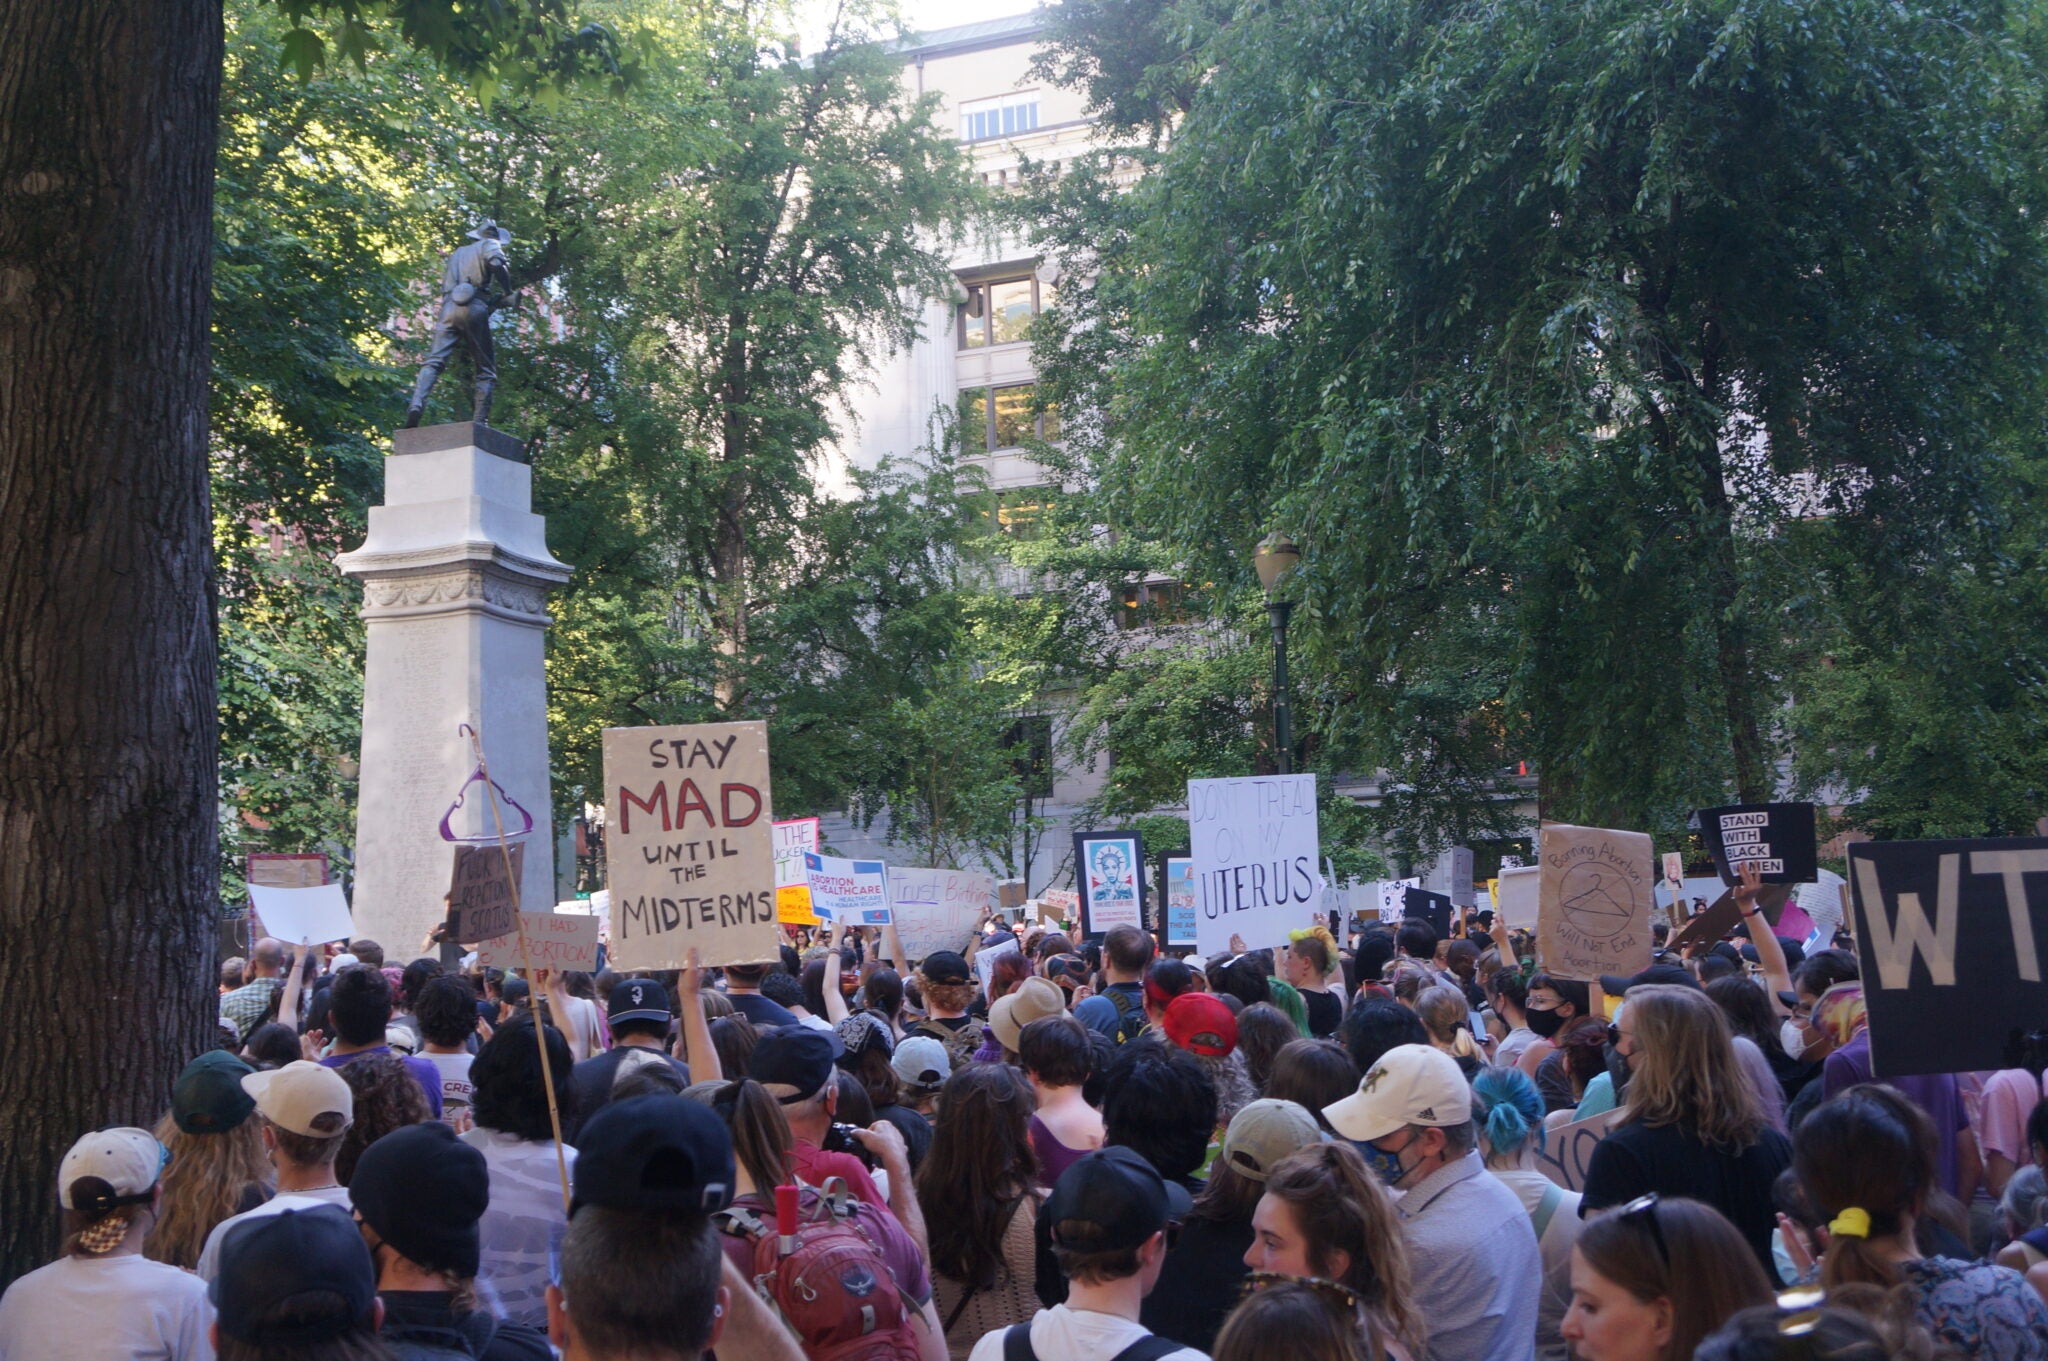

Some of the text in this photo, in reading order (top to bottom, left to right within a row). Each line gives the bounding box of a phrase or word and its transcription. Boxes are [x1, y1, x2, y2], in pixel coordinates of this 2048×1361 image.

[650, 734, 737, 769] STAY
[619, 777, 762, 834] MAD
[1252, 779, 1314, 817] TREAD
[1721, 814, 1766, 828] STAND
[778, 822, 812, 845] THE
[1723, 831, 1757, 843] WITH
[643, 838, 738, 864] UNTIL
[1727, 845, 1767, 858] BLACK
[1599, 840, 1641, 886] Abortion
[1732, 861, 1781, 874] WMEN
[670, 864, 707, 884] THE
[811, 874, 854, 886] ABORTION
[819, 885, 881, 896] HEALTHCARE
[891, 875, 941, 901] Trust
[1202, 856, 1313, 920] UTERUS
[550, 918, 579, 933] HAD
[622, 891, 773, 939] MIDTERMS
[1610, 933, 1637, 953] End
